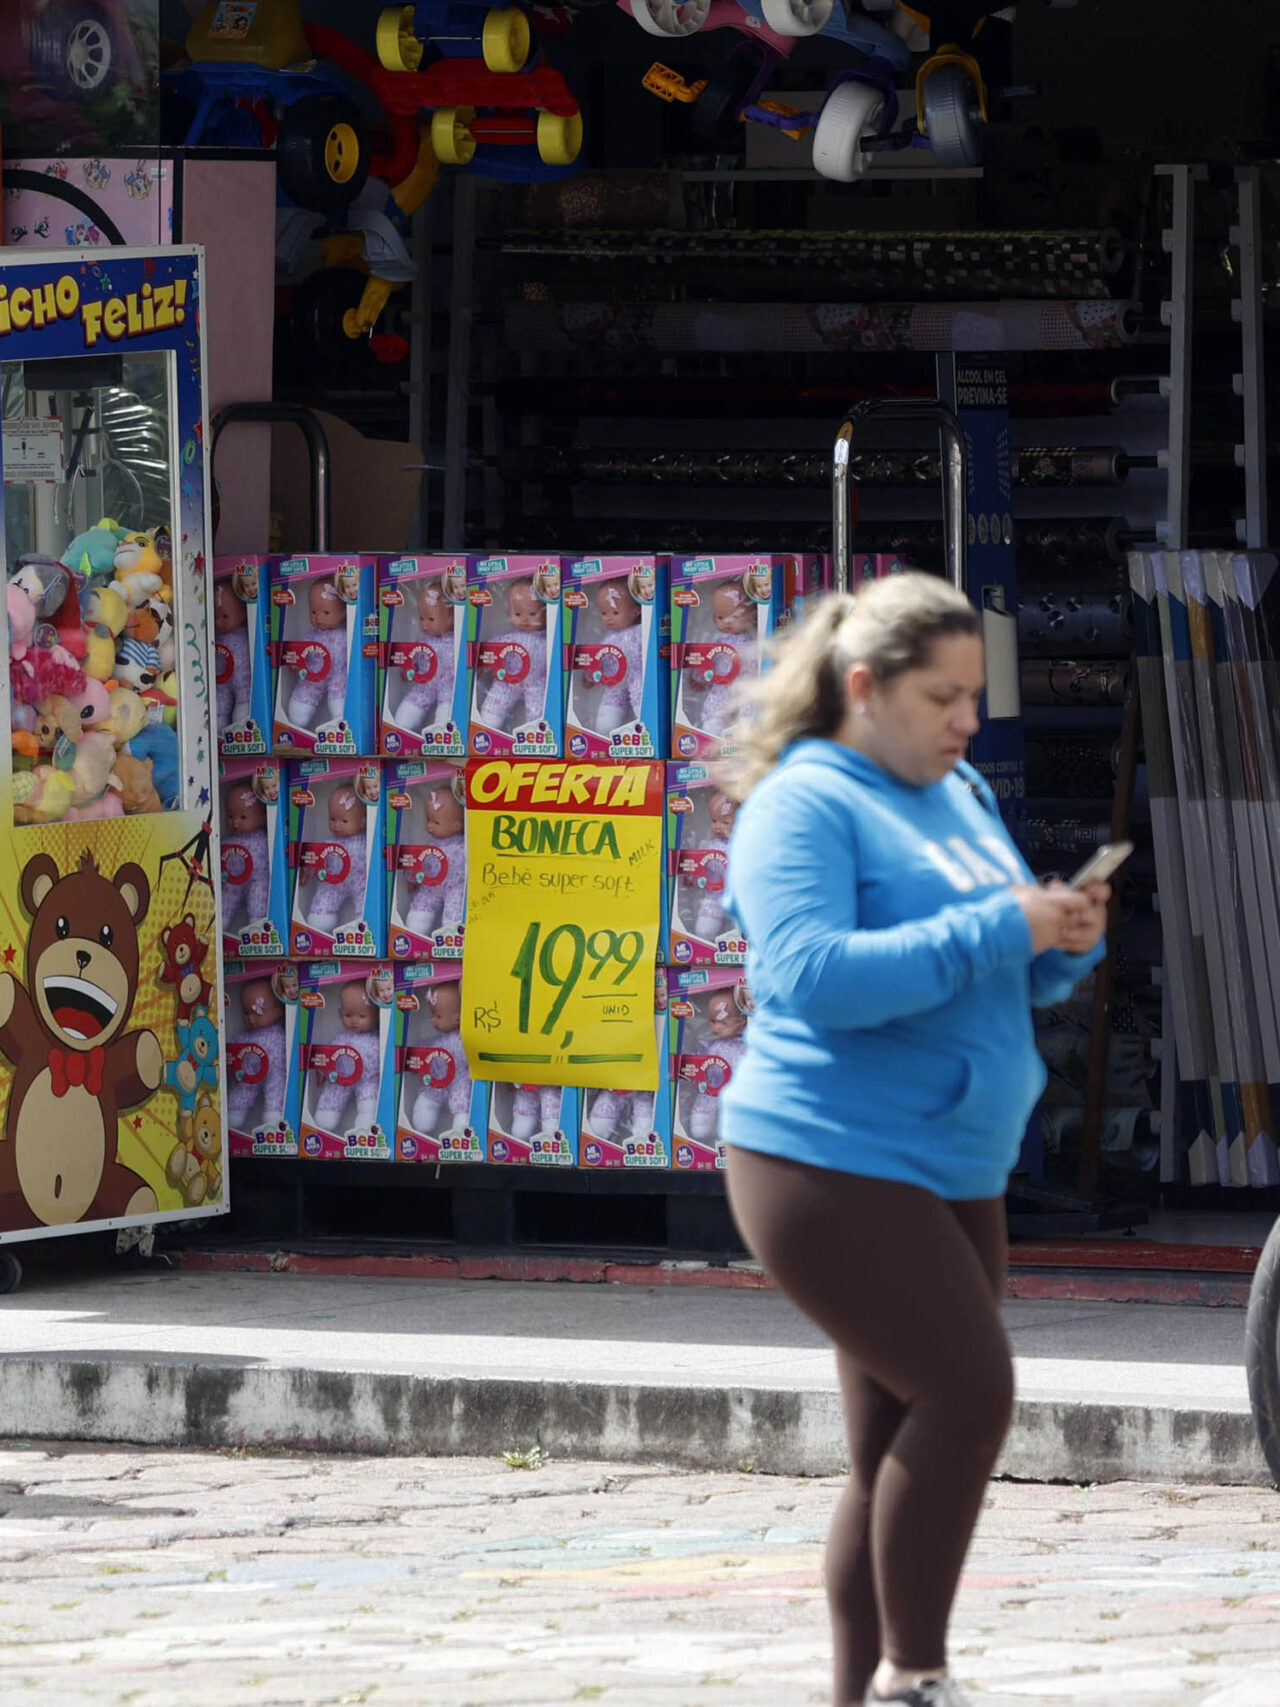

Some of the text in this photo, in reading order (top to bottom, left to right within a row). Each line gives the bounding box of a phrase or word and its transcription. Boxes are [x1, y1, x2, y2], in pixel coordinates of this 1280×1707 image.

[984, 370, 994, 382] EM
[995, 370, 1007, 383] GEL
[957, 387, 1007, 404] PREVINA-SE
[223, 743, 265, 753] SUPER SOFT
[315, 744, 355, 754] SUPER SOFT
[422, 745, 463, 754] SUPER SOFT
[514, 745, 556, 754] SUPER SOFT
[610, 746, 653, 756] SUPER SOFT
[470, 760, 651, 807] OFERTA
[492, 815, 621, 860] BONECA
[628, 839, 655, 866] MILK
[482, 863, 635, 896] Bebê super soft
[435, 934, 463, 947] BeB
[240, 945, 282, 955] SUPER SOFT
[334, 945, 375, 955] SUPER SOFT
[433, 947, 457, 957] SUPER
[718, 941, 746, 953] BeB
[716, 953, 741, 963] SUPER
[474, 922, 645, 1049] R$ 19,99
[602, 1005, 631, 1016] UNID
[253, 1144, 276, 1153] SUPER
[345, 1148, 370, 1157] SUPER
[440, 1151, 463, 1160] SUPER
[530, 1153, 553, 1163] SUPER
[625, 1156, 666, 1166] SUPER SOFT
